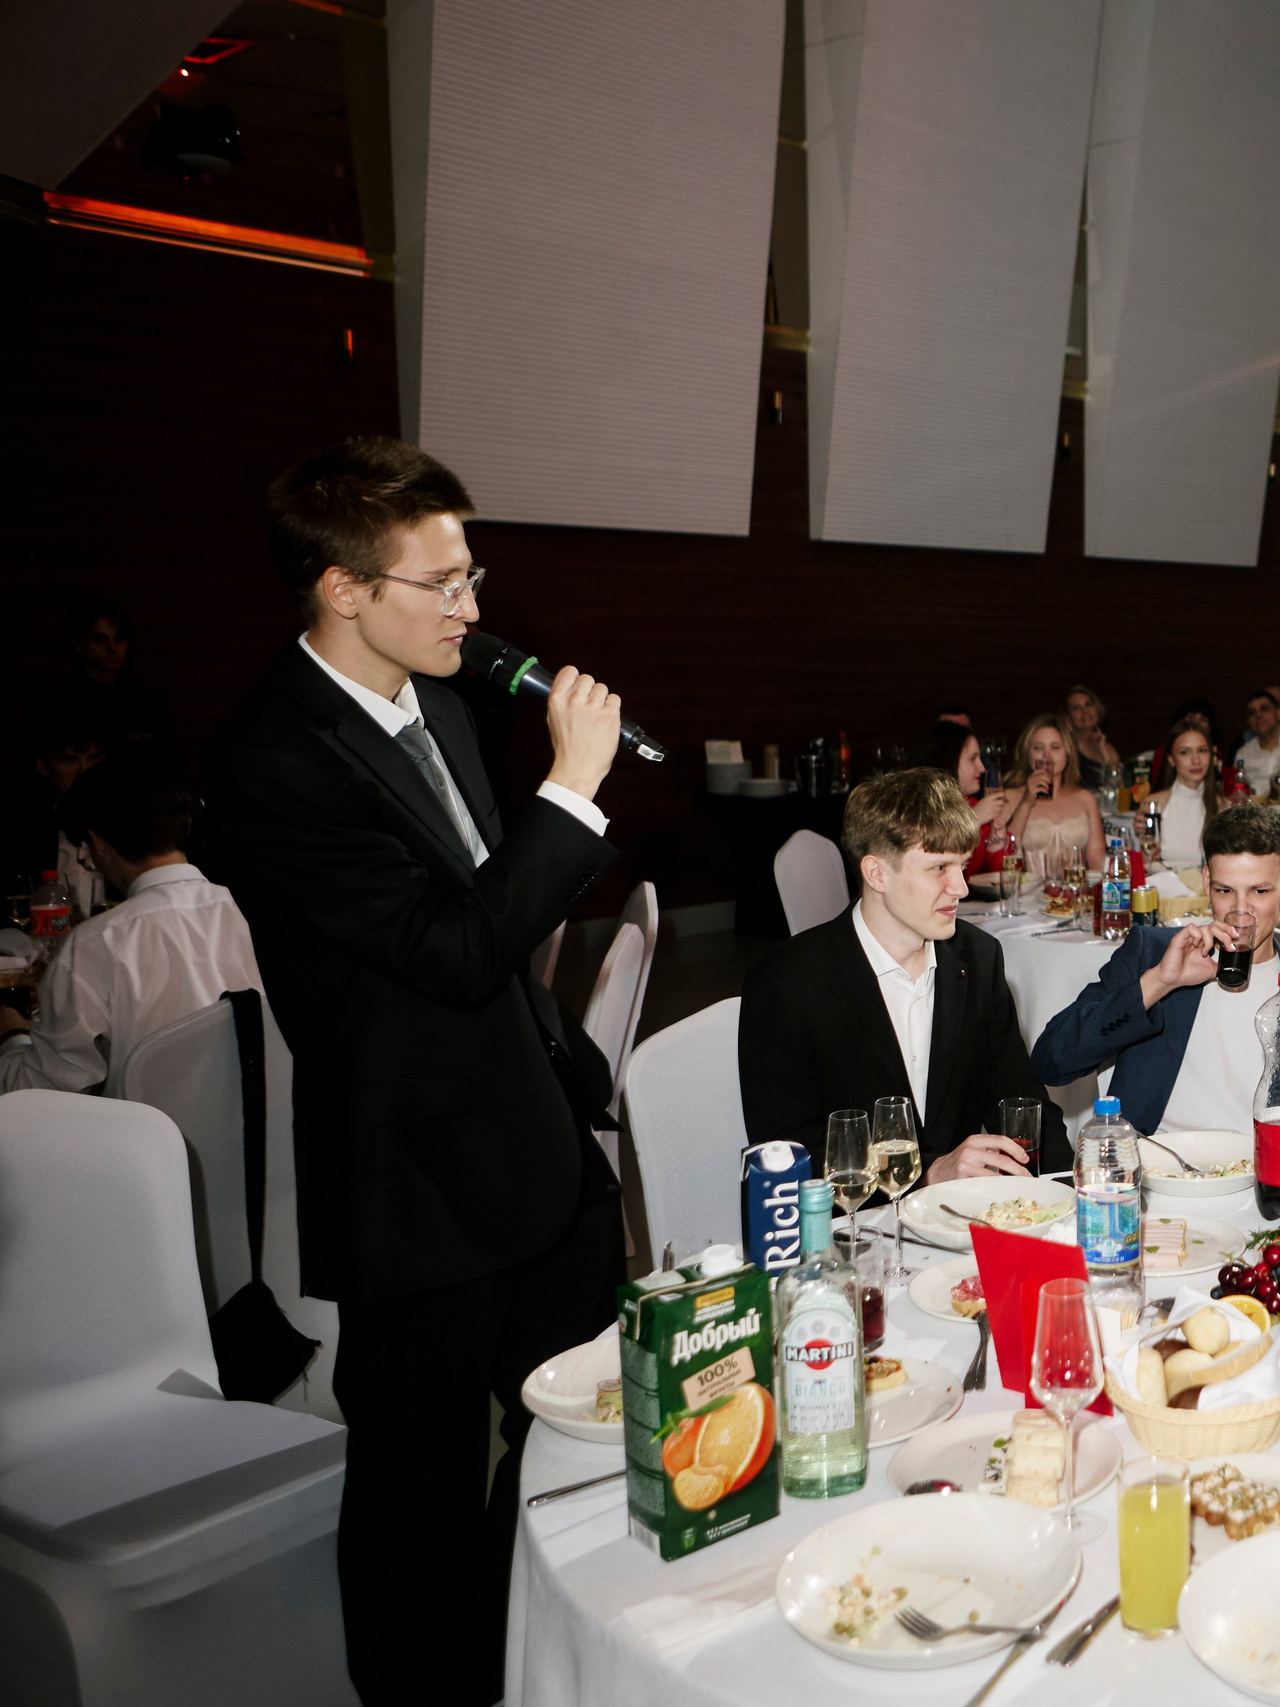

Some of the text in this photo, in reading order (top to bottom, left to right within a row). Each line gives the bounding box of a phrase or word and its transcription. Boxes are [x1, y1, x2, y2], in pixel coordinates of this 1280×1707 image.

[763, 1179, 800, 1272] Rich
[671, 1307, 760, 1367] Добрый
[787, 1342, 853, 1361] MARTINI
[697, 1356, 738, 1387] 100%
[795, 1381, 846, 1396] BIANCO
